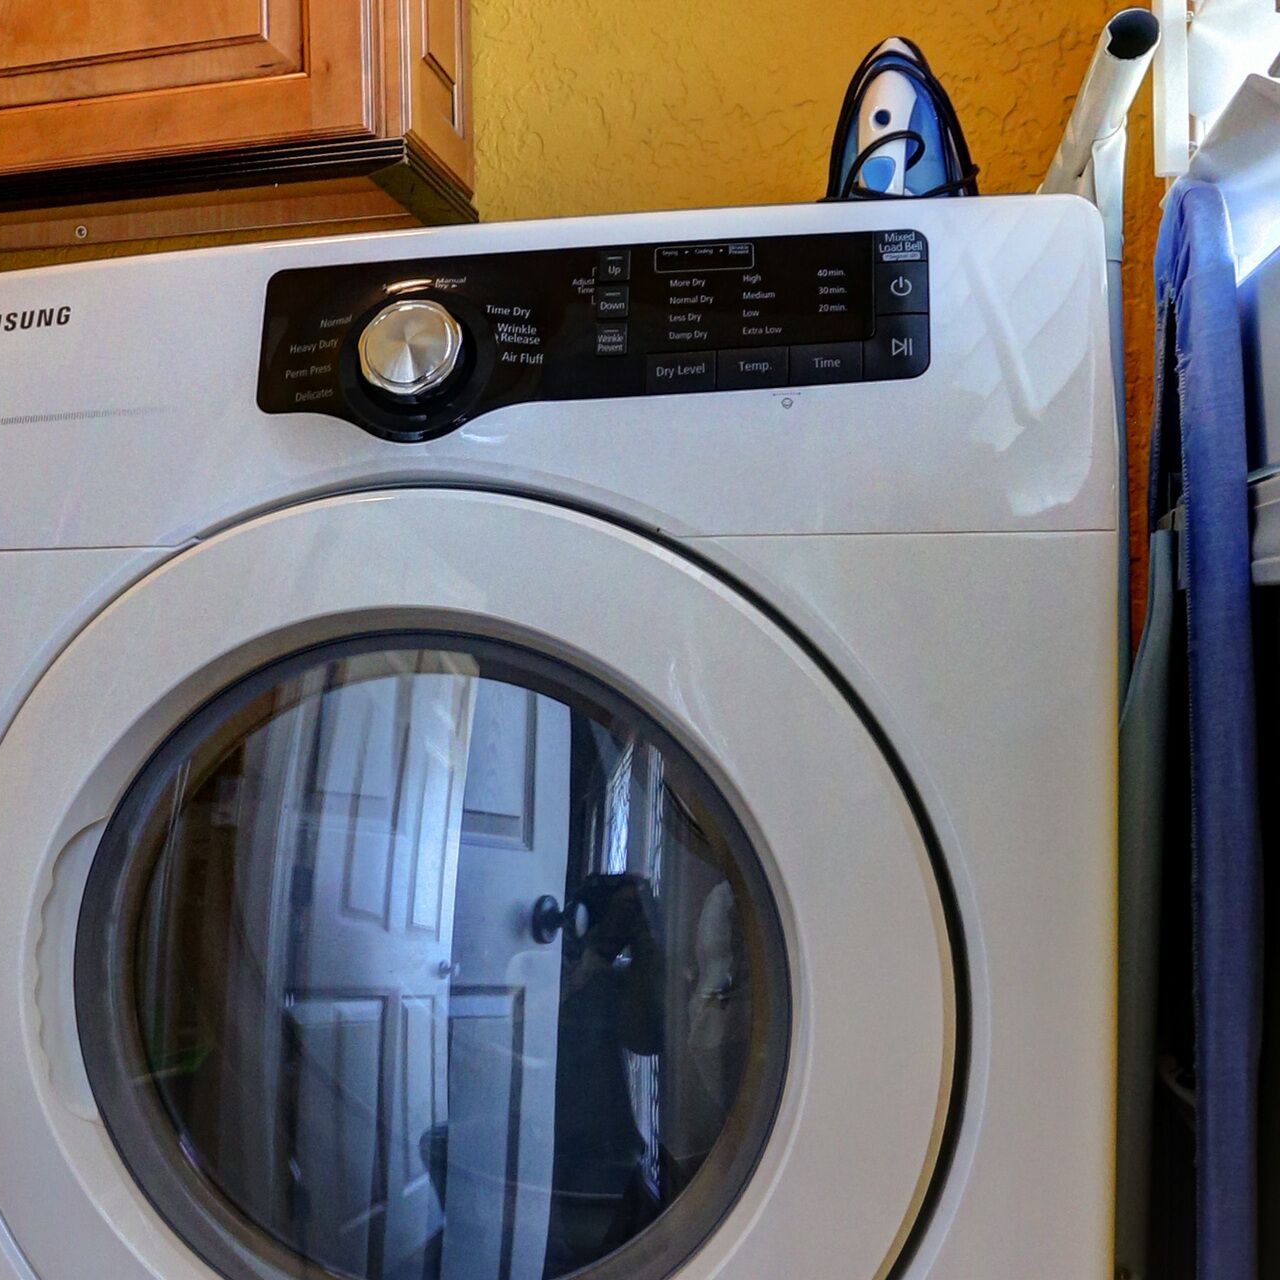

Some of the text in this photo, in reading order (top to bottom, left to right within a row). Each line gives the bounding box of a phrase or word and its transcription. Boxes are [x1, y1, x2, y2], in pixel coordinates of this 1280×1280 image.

[885, 232, 915, 242] Mixed
[879, 241, 922, 253] Load Bell
[608, 266, 621, 275] Up
[572, 278, 594, 286] Adjust
[670, 278, 706, 287] More Dry
[743, 274, 761, 284] High
[578, 286, 594, 294] Time
[743, 291, 776, 299] Medium
[670, 295, 714, 304] Normal Dry
[600, 301, 625, 310] Down
[486, 305, 531, 319] Time Dry
[670, 312, 702, 322] Less Dry
[743, 309, 759, 317] Low
[320, 314, 352, 328] Normal
[498, 323, 537, 334] Wrinkle
[743, 326, 782, 335] Extra Low
[501, 333, 540, 344] Release
[598, 334, 623, 343] Wrinkle
[669, 330, 708, 340] Damp Dry
[290, 338, 338, 354] Heavy Duty
[597, 343, 623, 352] Prevent
[502, 352, 544, 364] Air Fluff
[814, 358, 841, 368] Time
[286, 364, 332, 379] Perm Press
[656, 363, 705, 379] Dry Level
[738, 361, 773, 373] Temp.
[295, 388, 333, 402] Delicates
